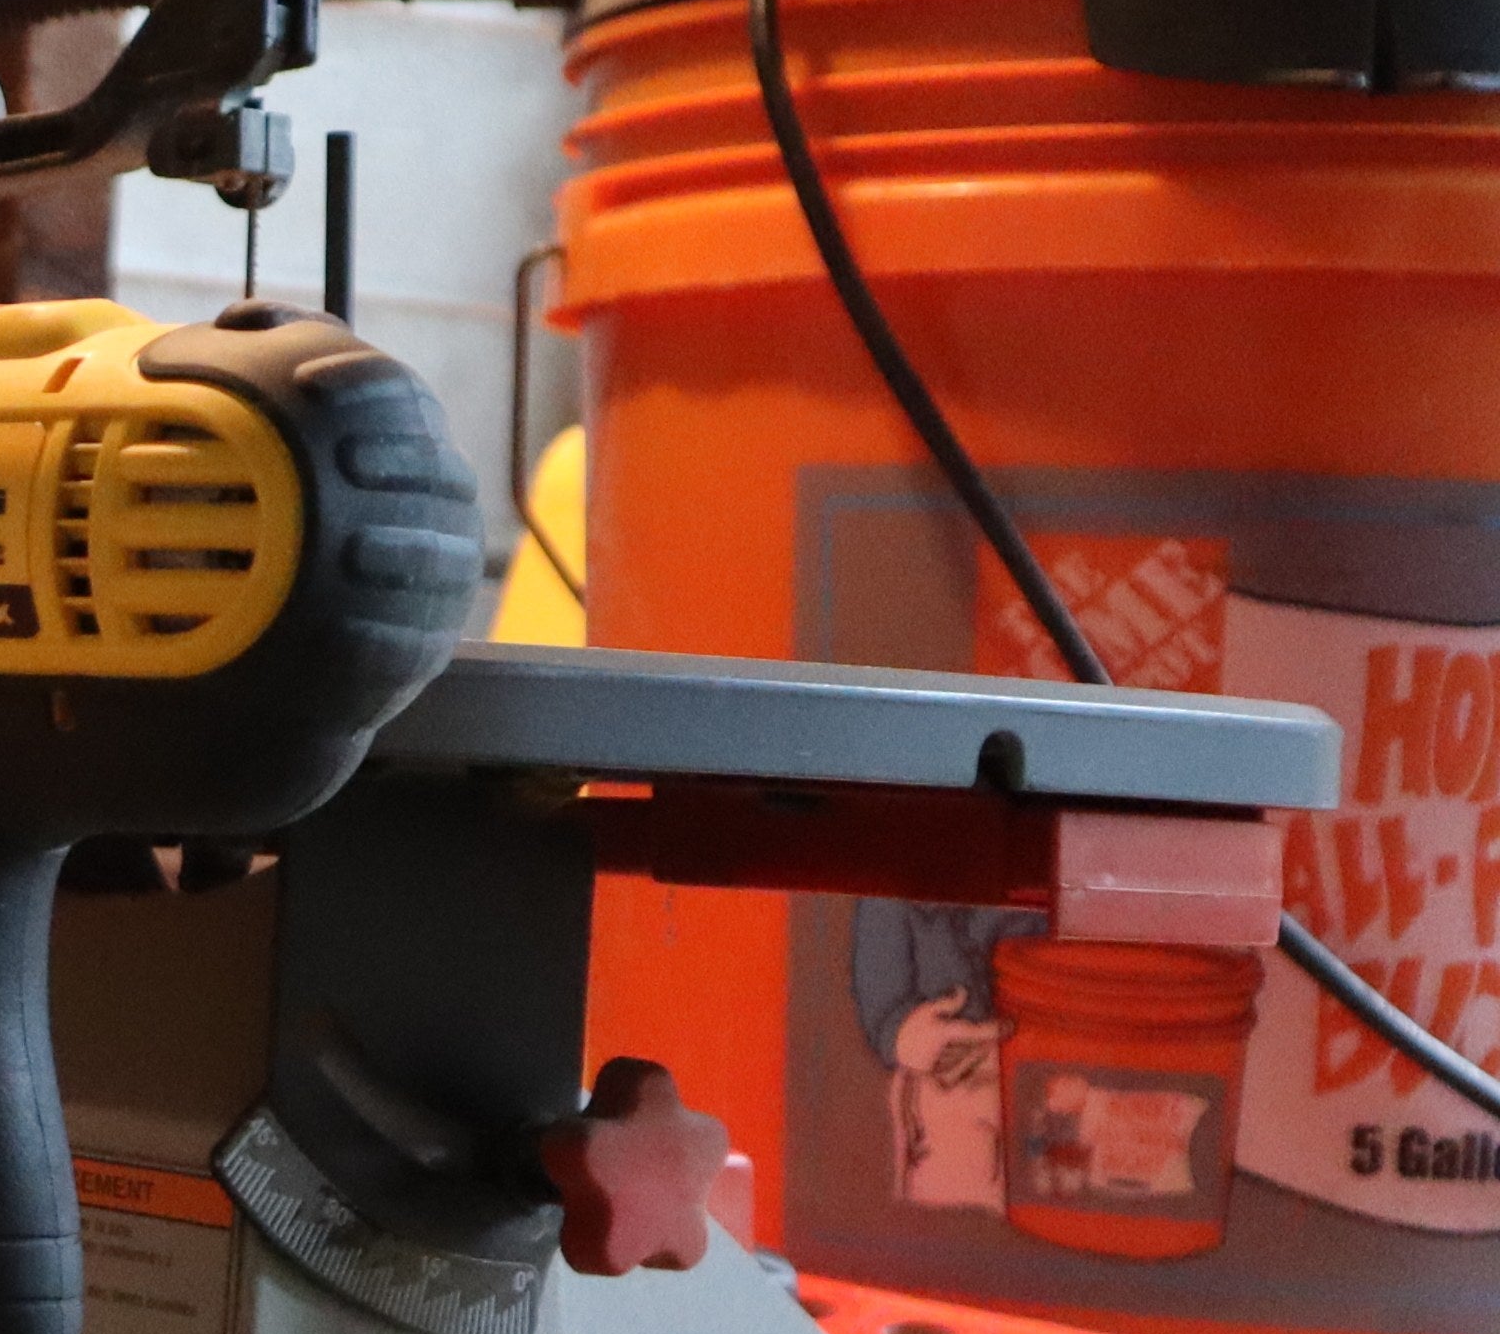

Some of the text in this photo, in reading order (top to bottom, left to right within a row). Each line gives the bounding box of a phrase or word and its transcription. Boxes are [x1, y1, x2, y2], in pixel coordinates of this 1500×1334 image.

[1355, 644, 1500, 806] HO
[1351, 1124, 1500, 1183] 5 Gall
[76, 1170, 156, 1204] EMENT
